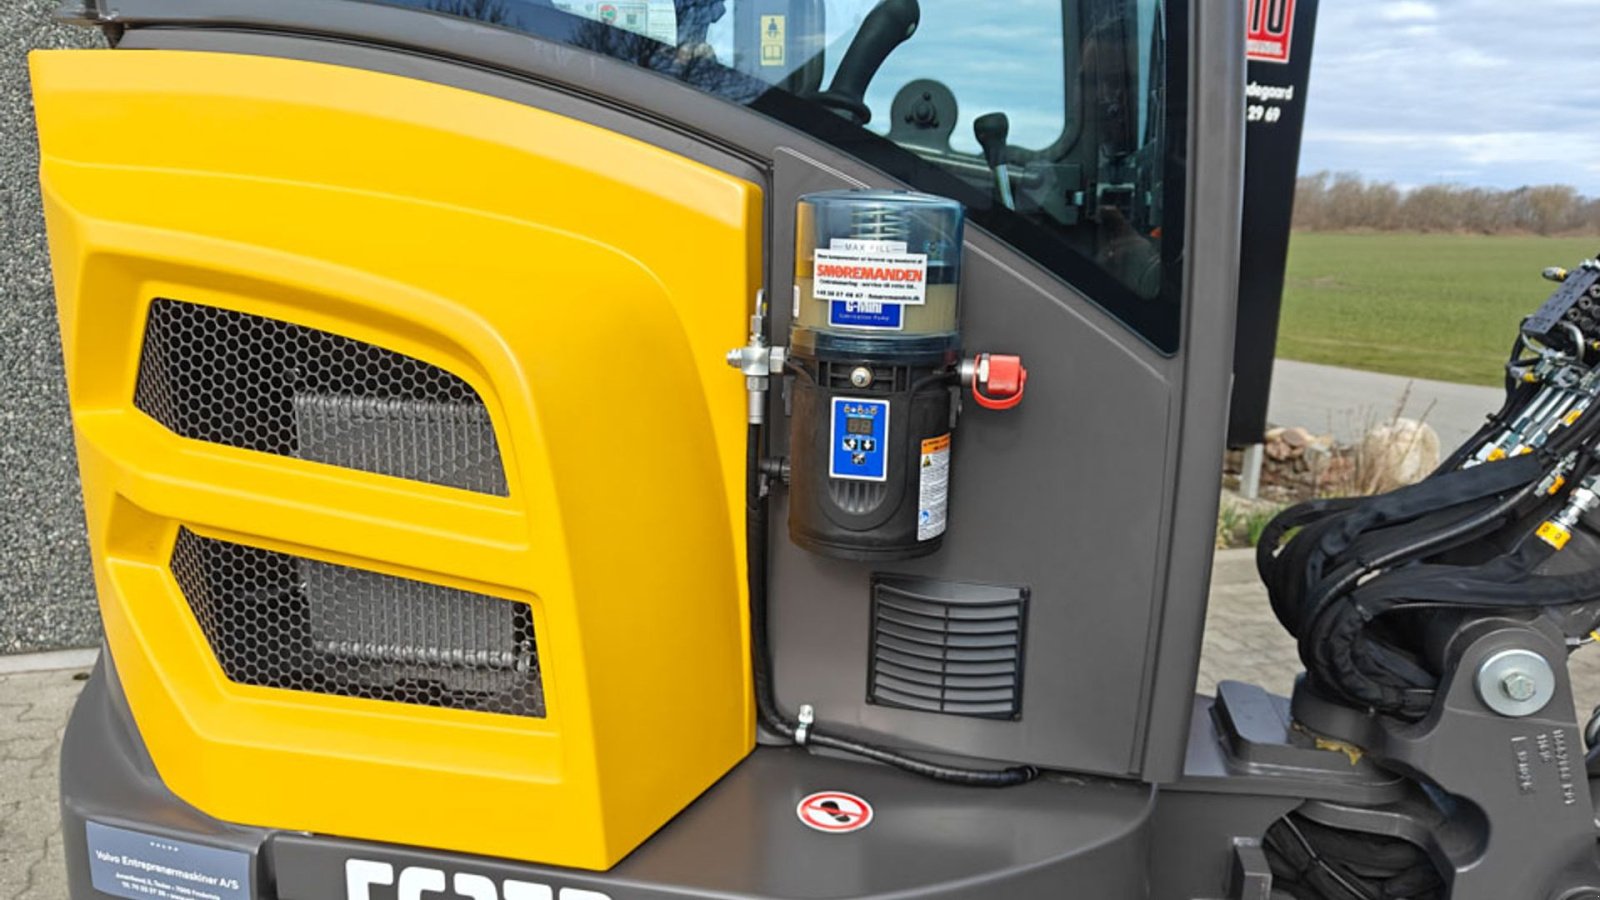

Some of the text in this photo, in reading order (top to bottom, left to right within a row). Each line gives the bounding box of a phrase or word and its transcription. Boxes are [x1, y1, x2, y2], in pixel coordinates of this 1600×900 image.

[1246, 81, 1294, 101] degaard
[845, 243, 865, 251] MAX
[817, 265, 923, 282] SMØREMANDEN
[95, 850, 120, 864] Volvo
[219, 878, 240, 890] A/S
